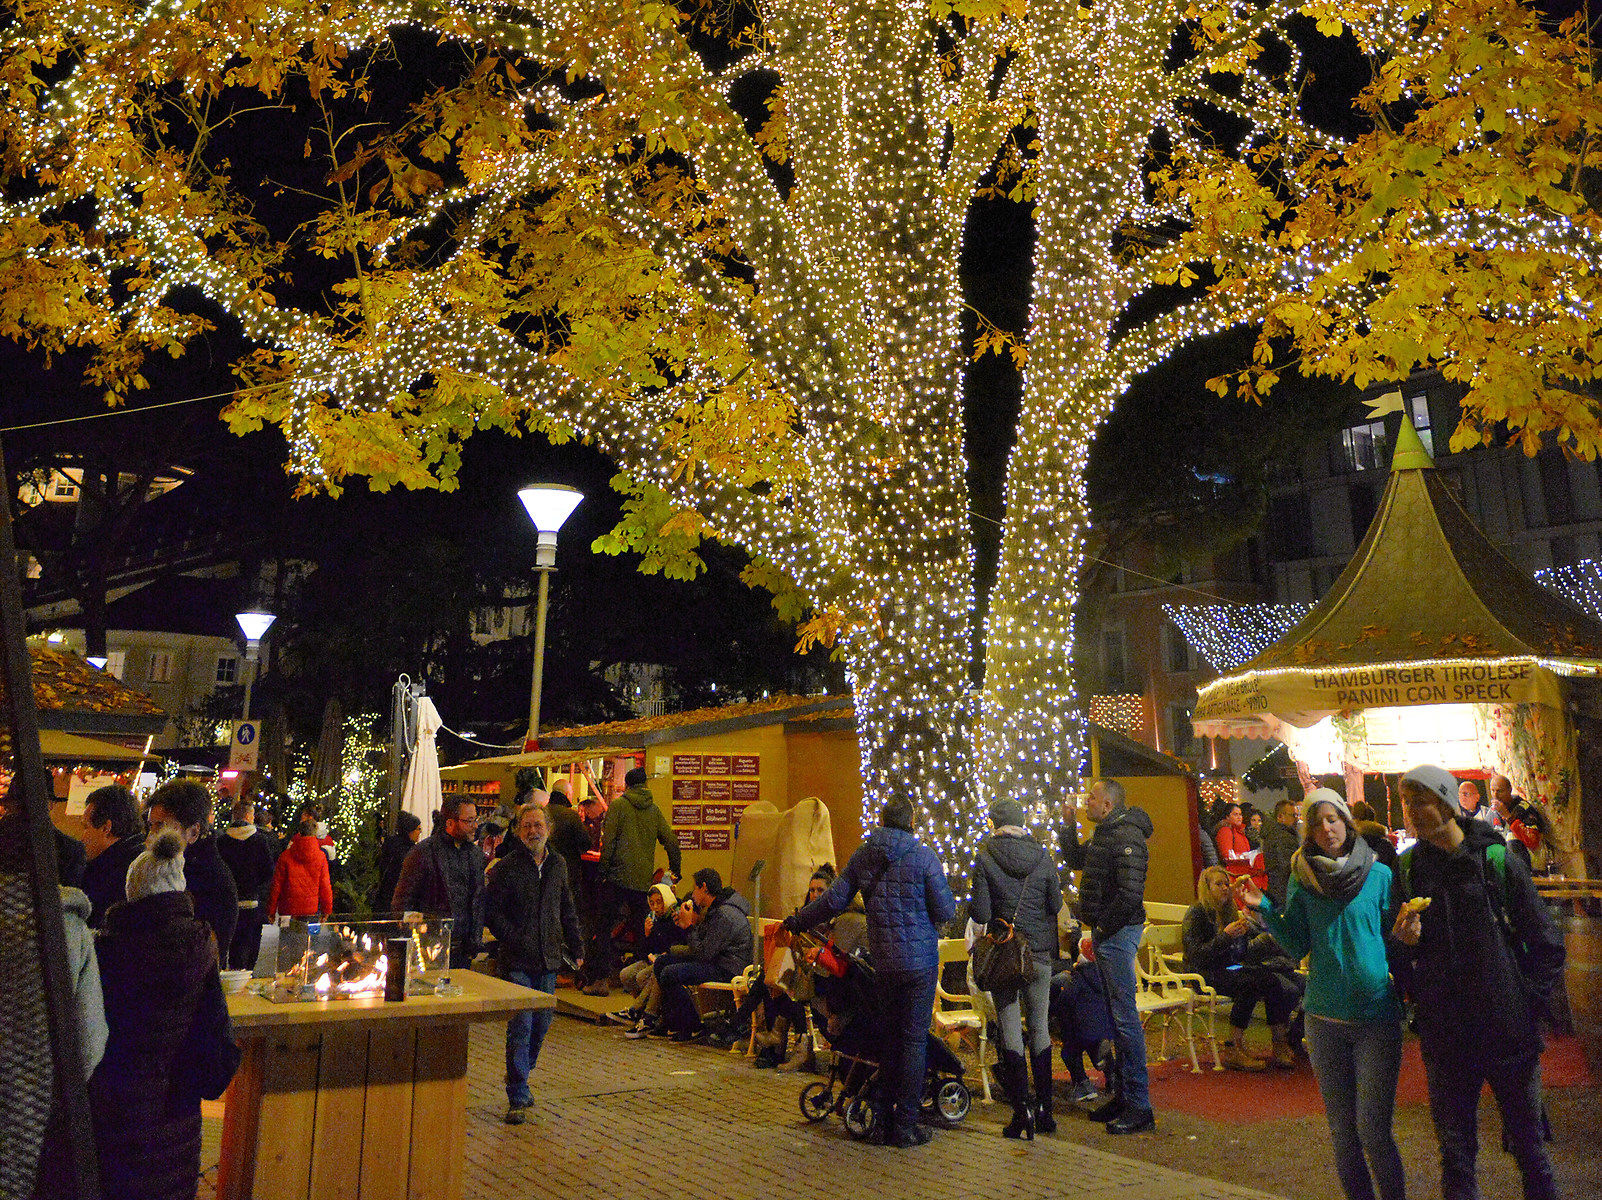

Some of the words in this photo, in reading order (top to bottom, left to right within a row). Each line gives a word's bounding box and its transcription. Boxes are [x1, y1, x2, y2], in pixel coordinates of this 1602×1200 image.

[1313, 666, 1436, 688] HAMBURGER
[1441, 664, 1530, 683] TIROLESE
[1336, 687, 1399, 705] PANINI
[1406, 685, 1447, 702] CON
[1453, 683, 1512, 700] SPECK
